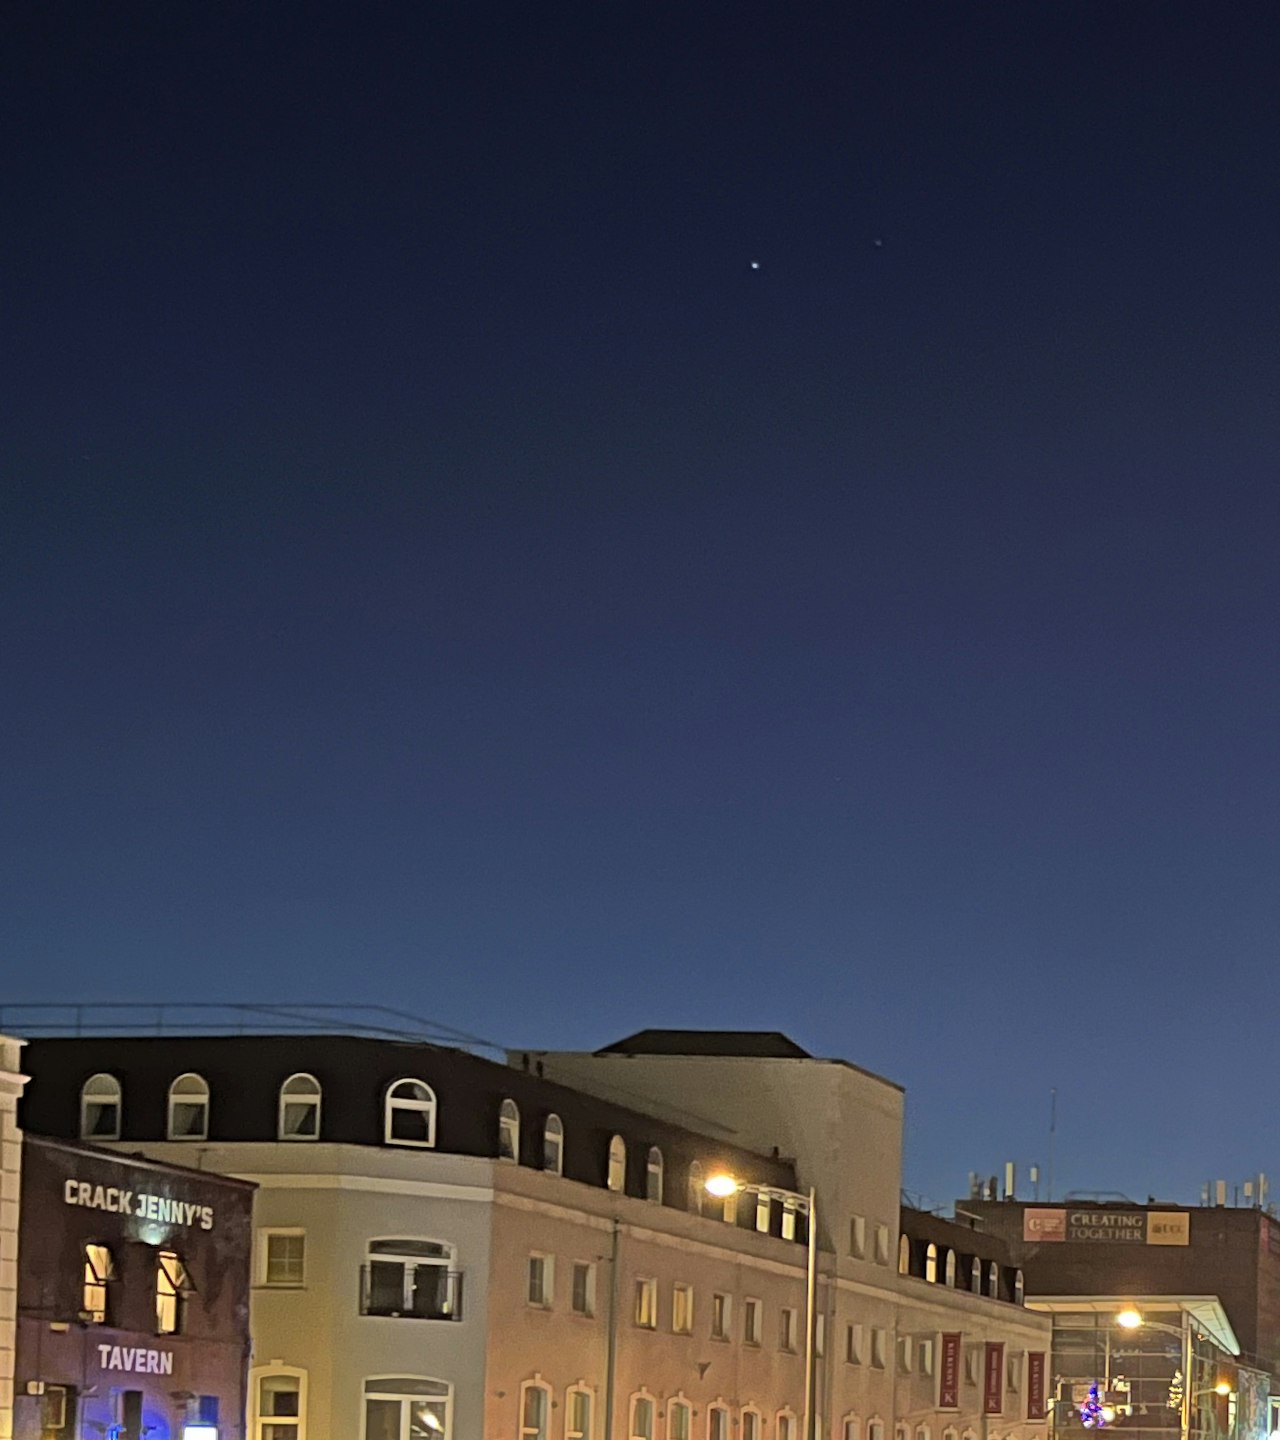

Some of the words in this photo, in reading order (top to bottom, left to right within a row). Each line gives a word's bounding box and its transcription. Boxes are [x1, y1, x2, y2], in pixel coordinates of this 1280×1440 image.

[64, 1179, 133, 1215] CRACK
[135, 1193, 214, 1230] JENNY'S
[1070, 1213, 1143, 1228] CREATING
[1070, 1227, 1143, 1241] TOGETHER
[97, 1344, 173, 1375] TAVERN
